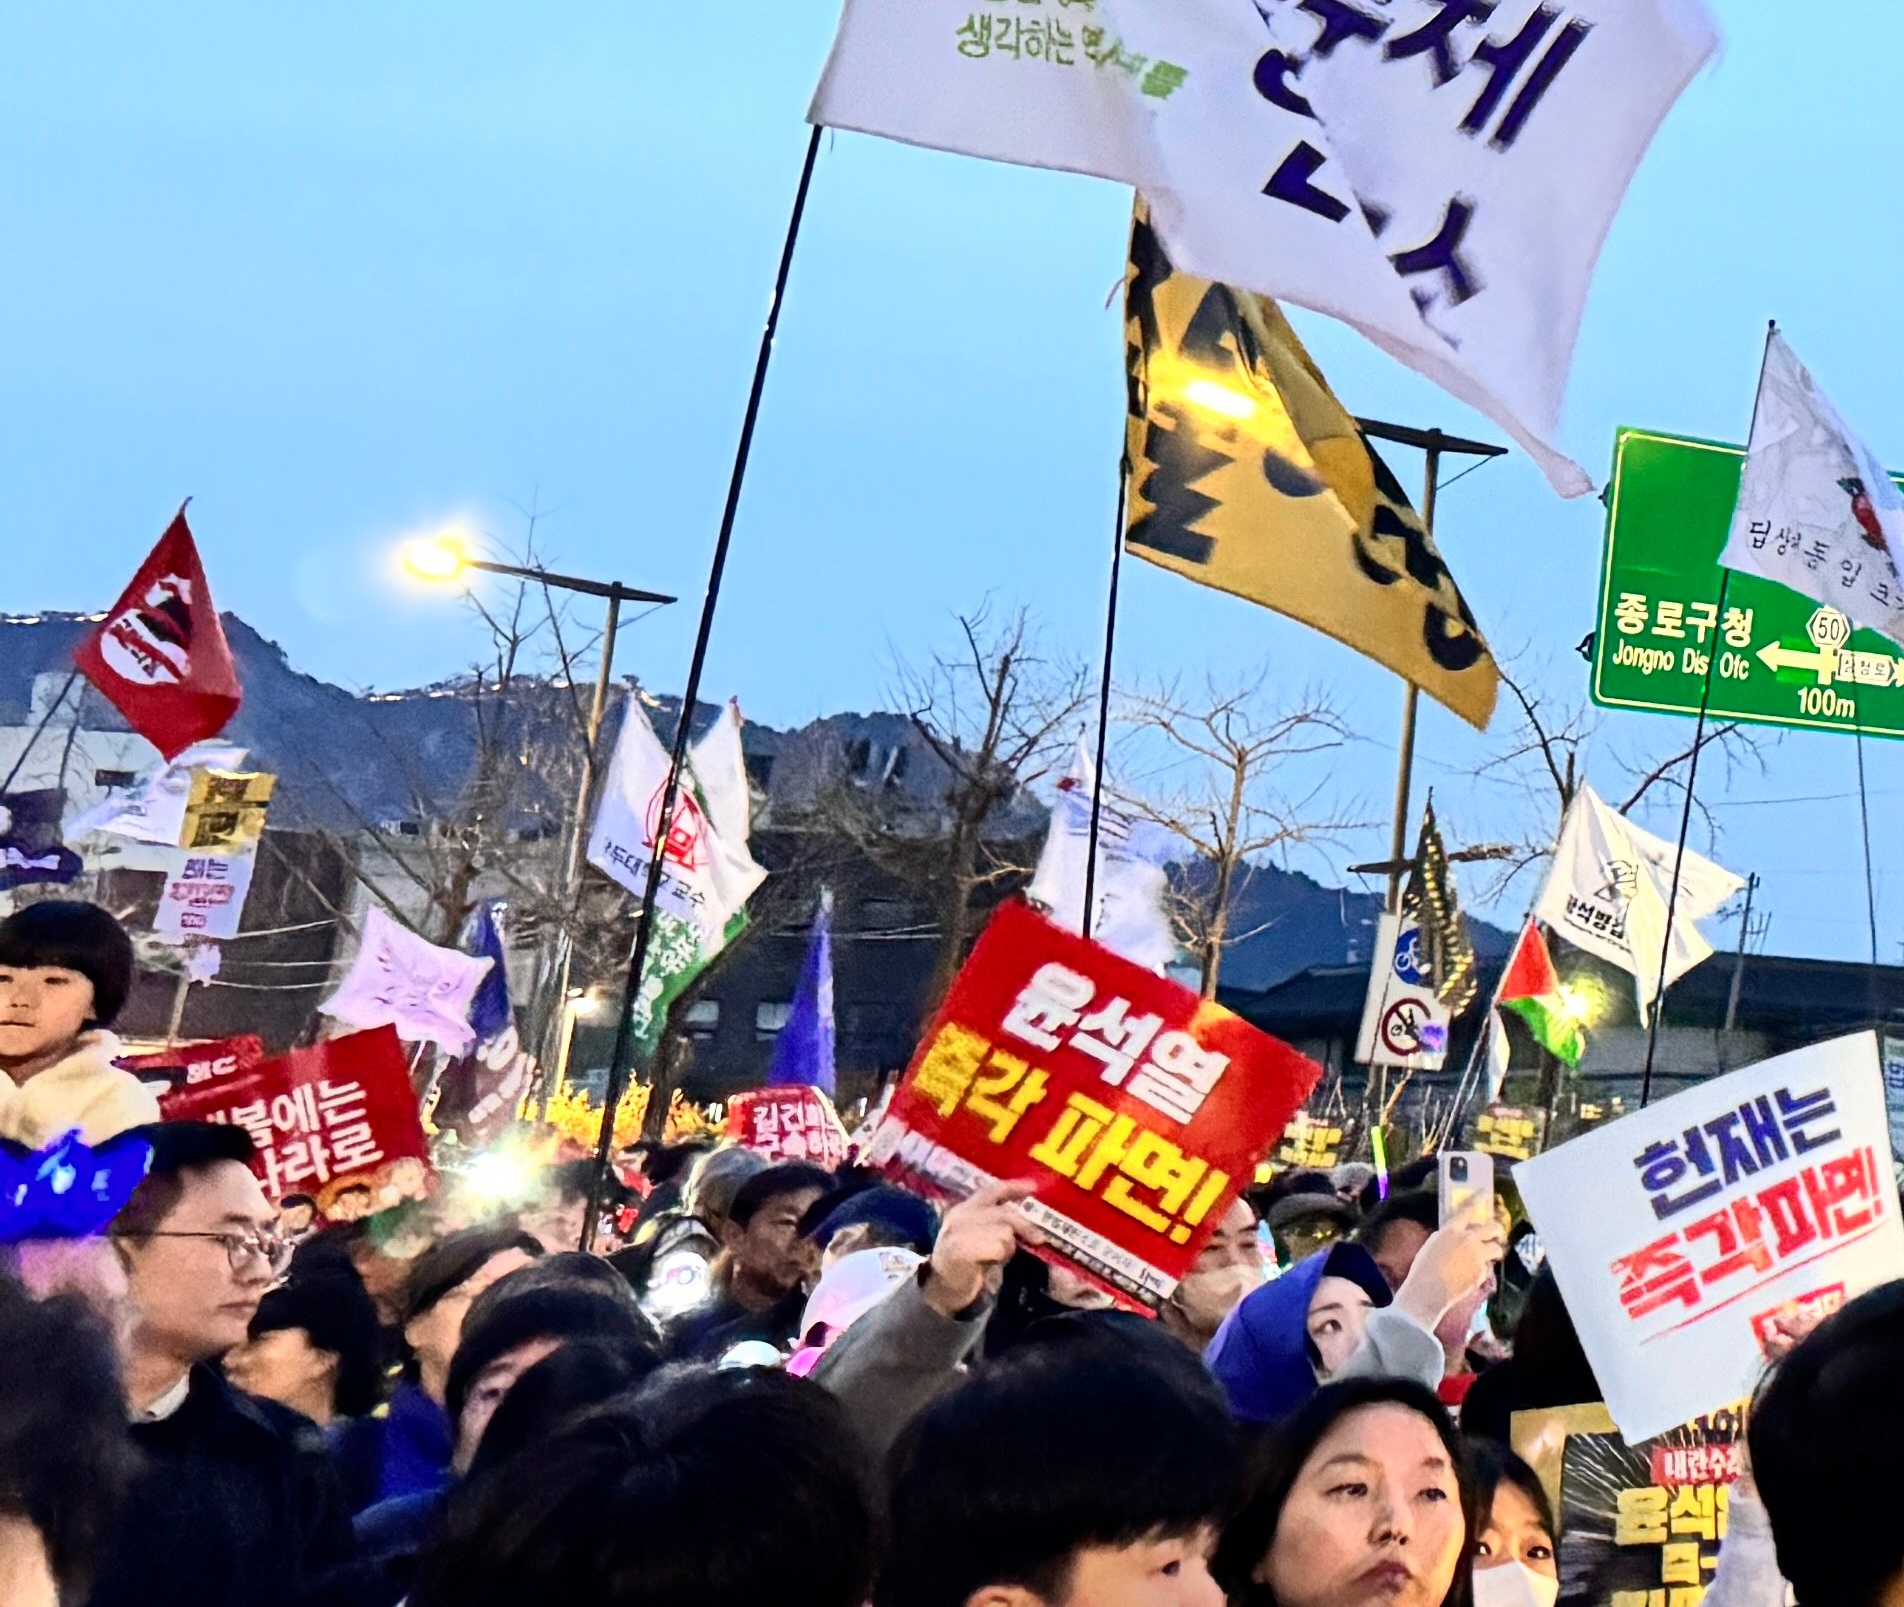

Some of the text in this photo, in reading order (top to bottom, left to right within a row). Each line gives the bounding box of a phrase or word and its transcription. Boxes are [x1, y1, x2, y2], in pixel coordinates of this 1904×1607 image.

[955, 13, 1074, 66] 생각하는
[1615, 592, 1753, 647] 종로구청
[1818, 617, 1840, 644] 50
[1613, 638, 1749, 680] Jongno Dis Ofc
[1798, 687, 1855, 718] 100m
[1000, 961, 1231, 1125] 윤석열
[206, 1078, 367, 1148] 봄에는
[909, 1020, 1231, 1246] 즉각 파면!
[1633, 1087, 1842, 1221] 헌재는
